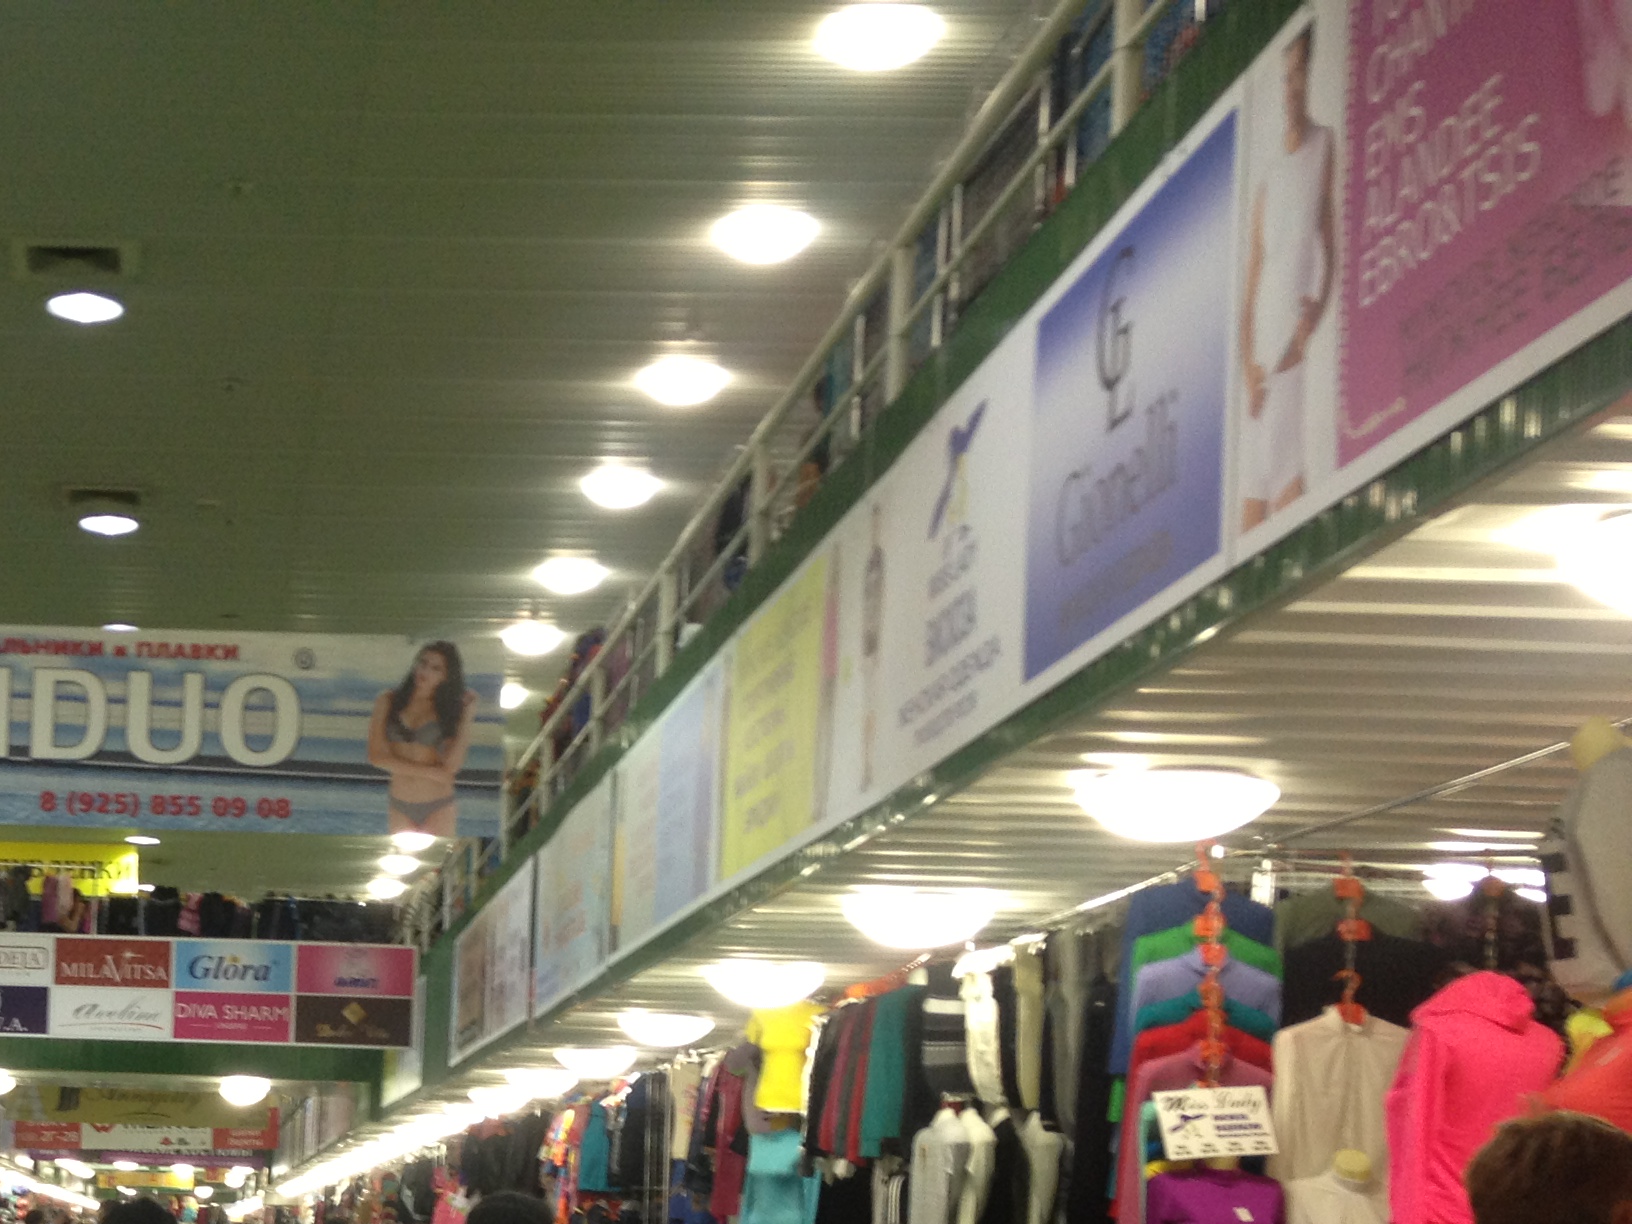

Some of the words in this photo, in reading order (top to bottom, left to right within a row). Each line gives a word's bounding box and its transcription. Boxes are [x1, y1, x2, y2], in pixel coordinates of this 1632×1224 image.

[135, 640, 239, 660] ПЛАВКИ
[40, 790, 57, 812] 8
[66, 792, 141, 818] (925)
[149, 795, 201, 816] 855
[212, 796, 247, 818] 09
[175, 1002, 219, 1019] DIVA
[224, 1004, 290, 1023] SHARM
